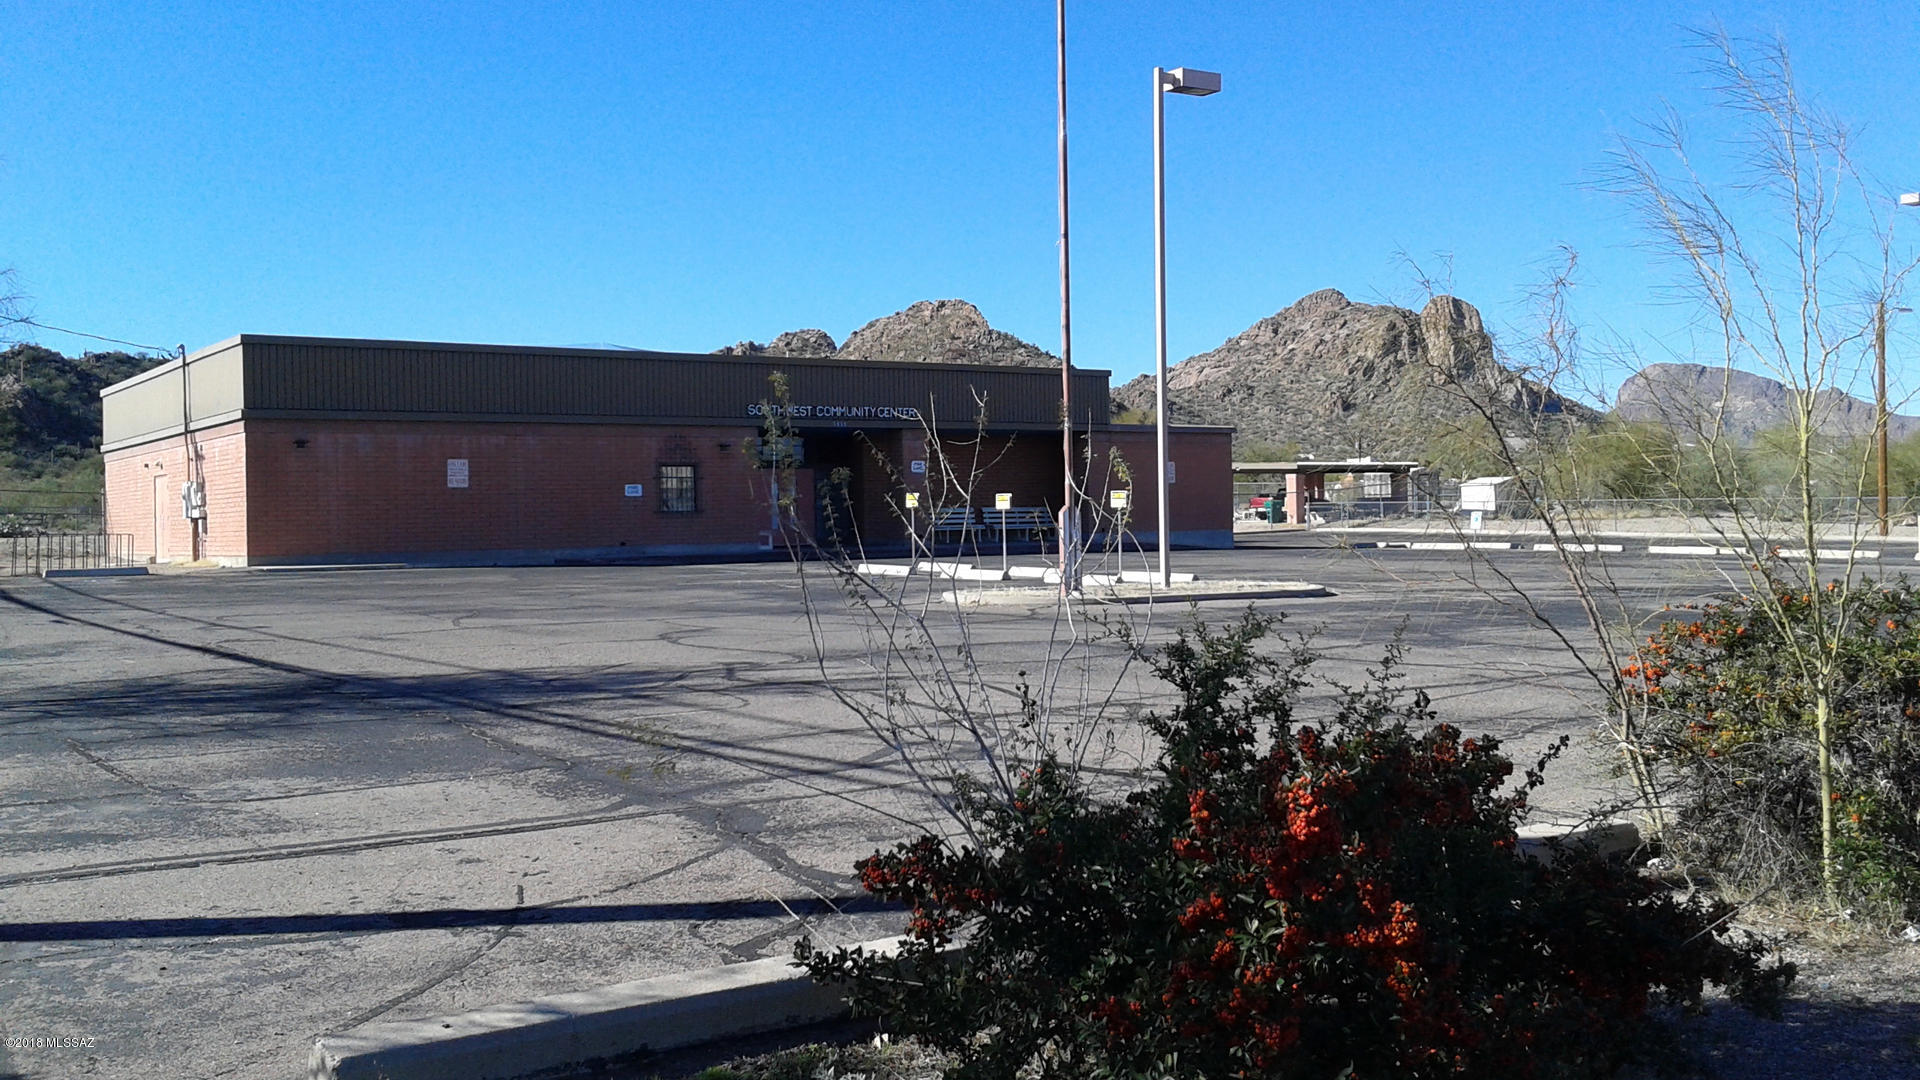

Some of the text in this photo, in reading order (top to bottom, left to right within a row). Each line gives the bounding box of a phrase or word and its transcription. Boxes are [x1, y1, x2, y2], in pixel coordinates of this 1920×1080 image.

[747, 404, 916, 418] SOTHWEST COMMUNITY CENTER
